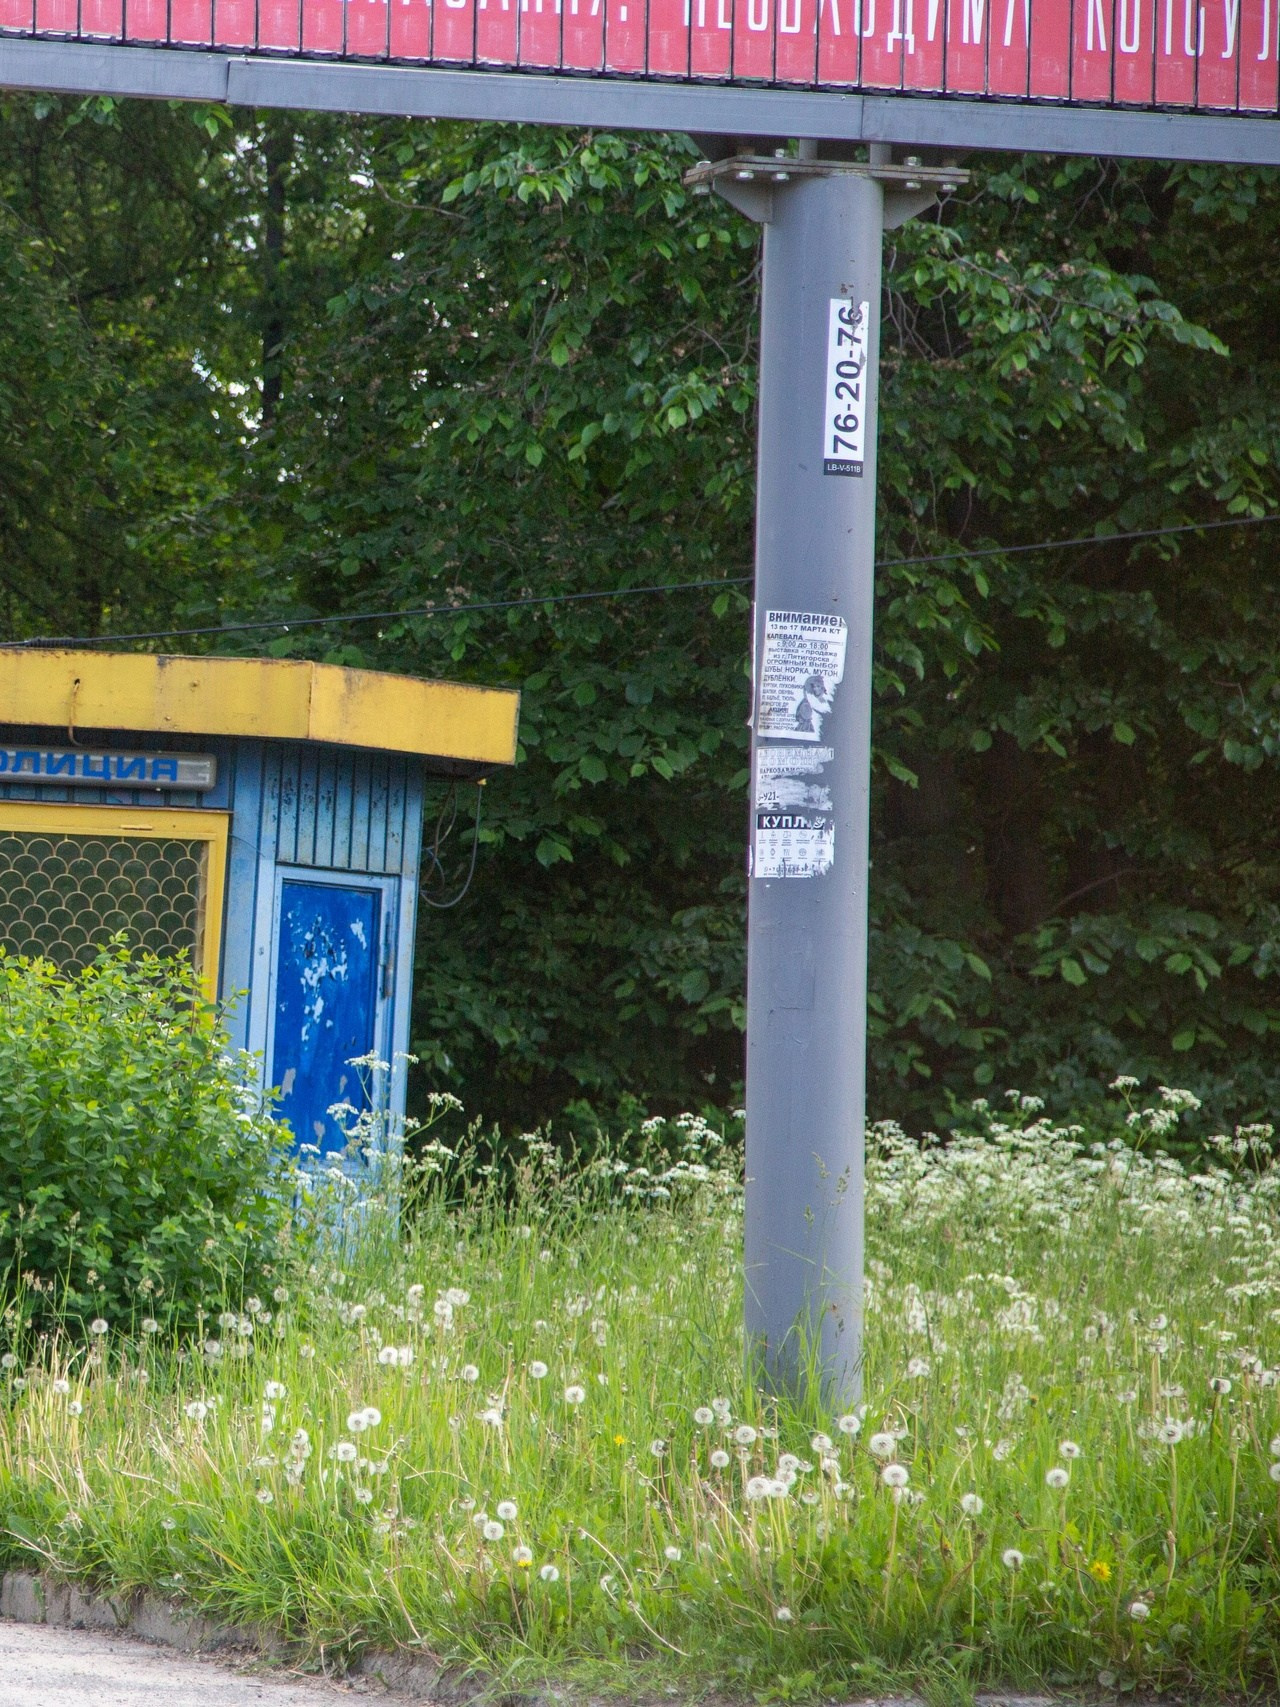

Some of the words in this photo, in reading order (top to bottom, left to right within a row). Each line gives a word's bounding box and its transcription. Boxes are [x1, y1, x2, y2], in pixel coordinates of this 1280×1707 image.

[833, 306, 863, 454] 76-20-76
[800, 625, 827, 633] МАРТА
[788, 654, 829, 662] Пятигорска
[763, 816, 810, 828] КУПЛ
